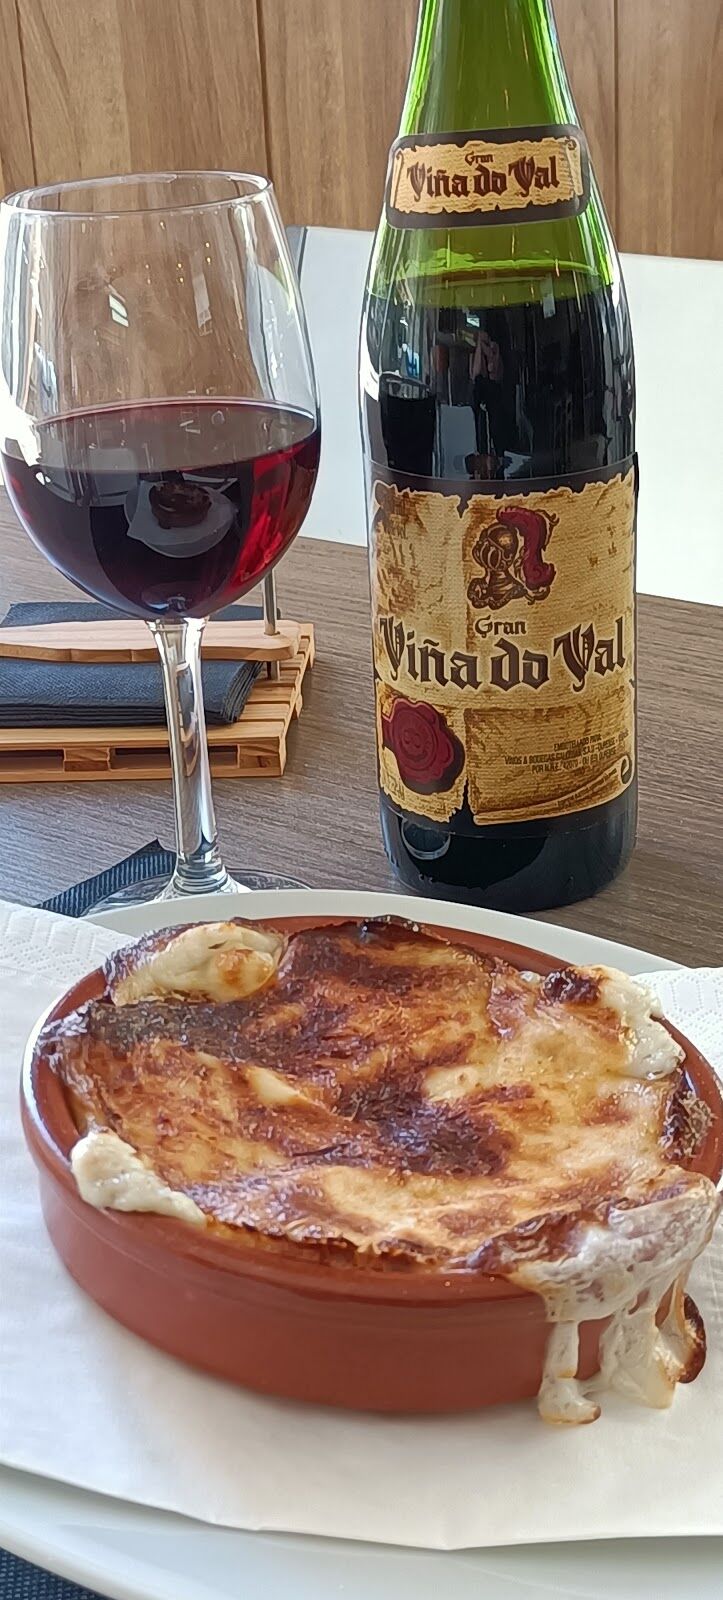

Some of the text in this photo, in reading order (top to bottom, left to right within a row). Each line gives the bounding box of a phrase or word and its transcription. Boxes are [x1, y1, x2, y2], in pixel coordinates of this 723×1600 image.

[465, 151, 494, 166] Gran
[407, 161, 470, 202] Viña
[508, 155, 560, 198] Val
[475, 615, 527, 638] Gran
[380, 615, 482, 690] Viña
[553, 616, 626, 692] Val
